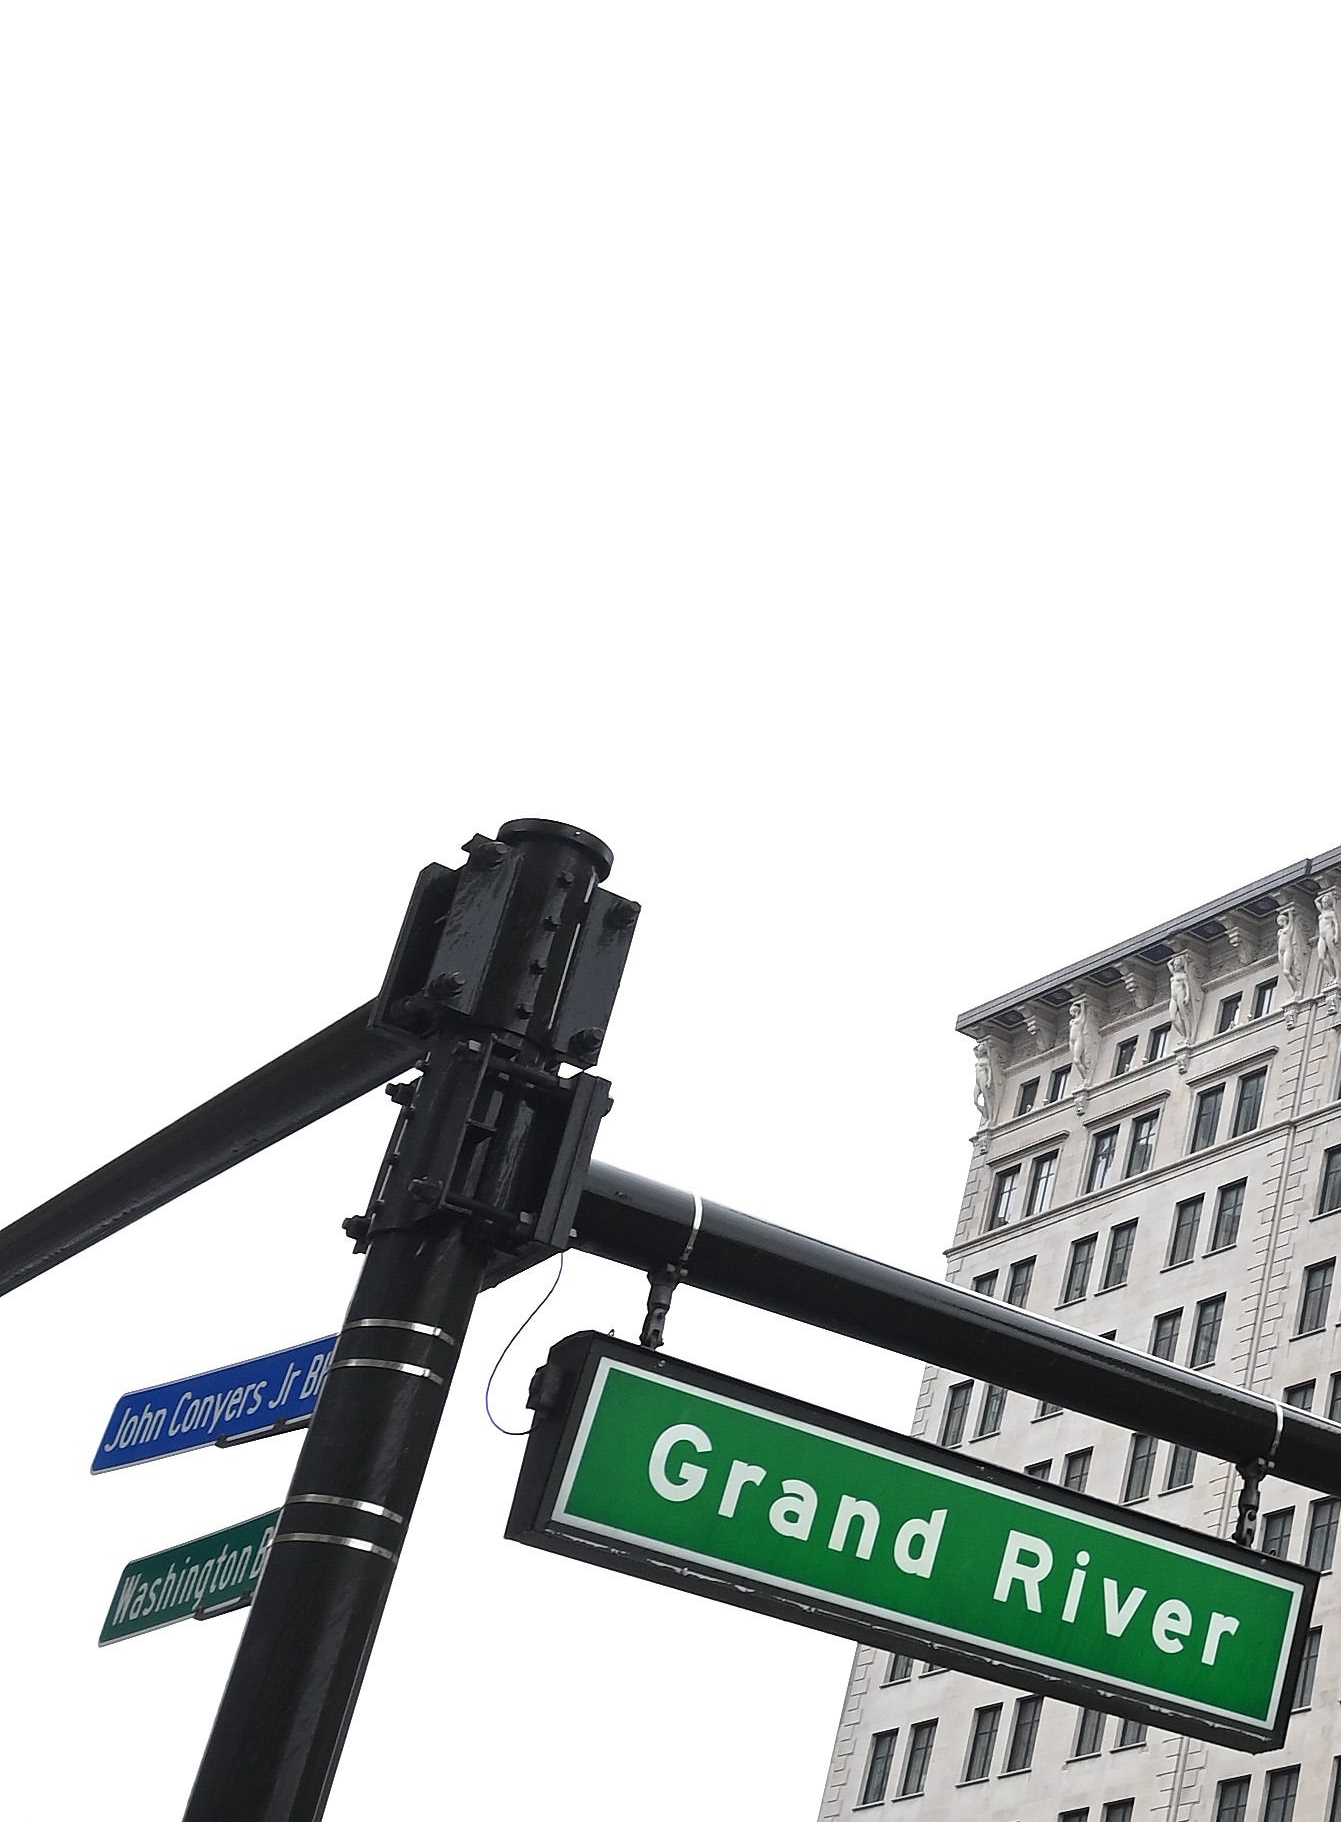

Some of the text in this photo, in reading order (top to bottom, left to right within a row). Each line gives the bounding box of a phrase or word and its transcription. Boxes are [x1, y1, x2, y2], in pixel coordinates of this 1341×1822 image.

[103, 1351, 331, 1453] John Conyers Jr Bl
[111, 1543, 252, 1627] Washington
[647, 1423, 1240, 1667] Grand River
